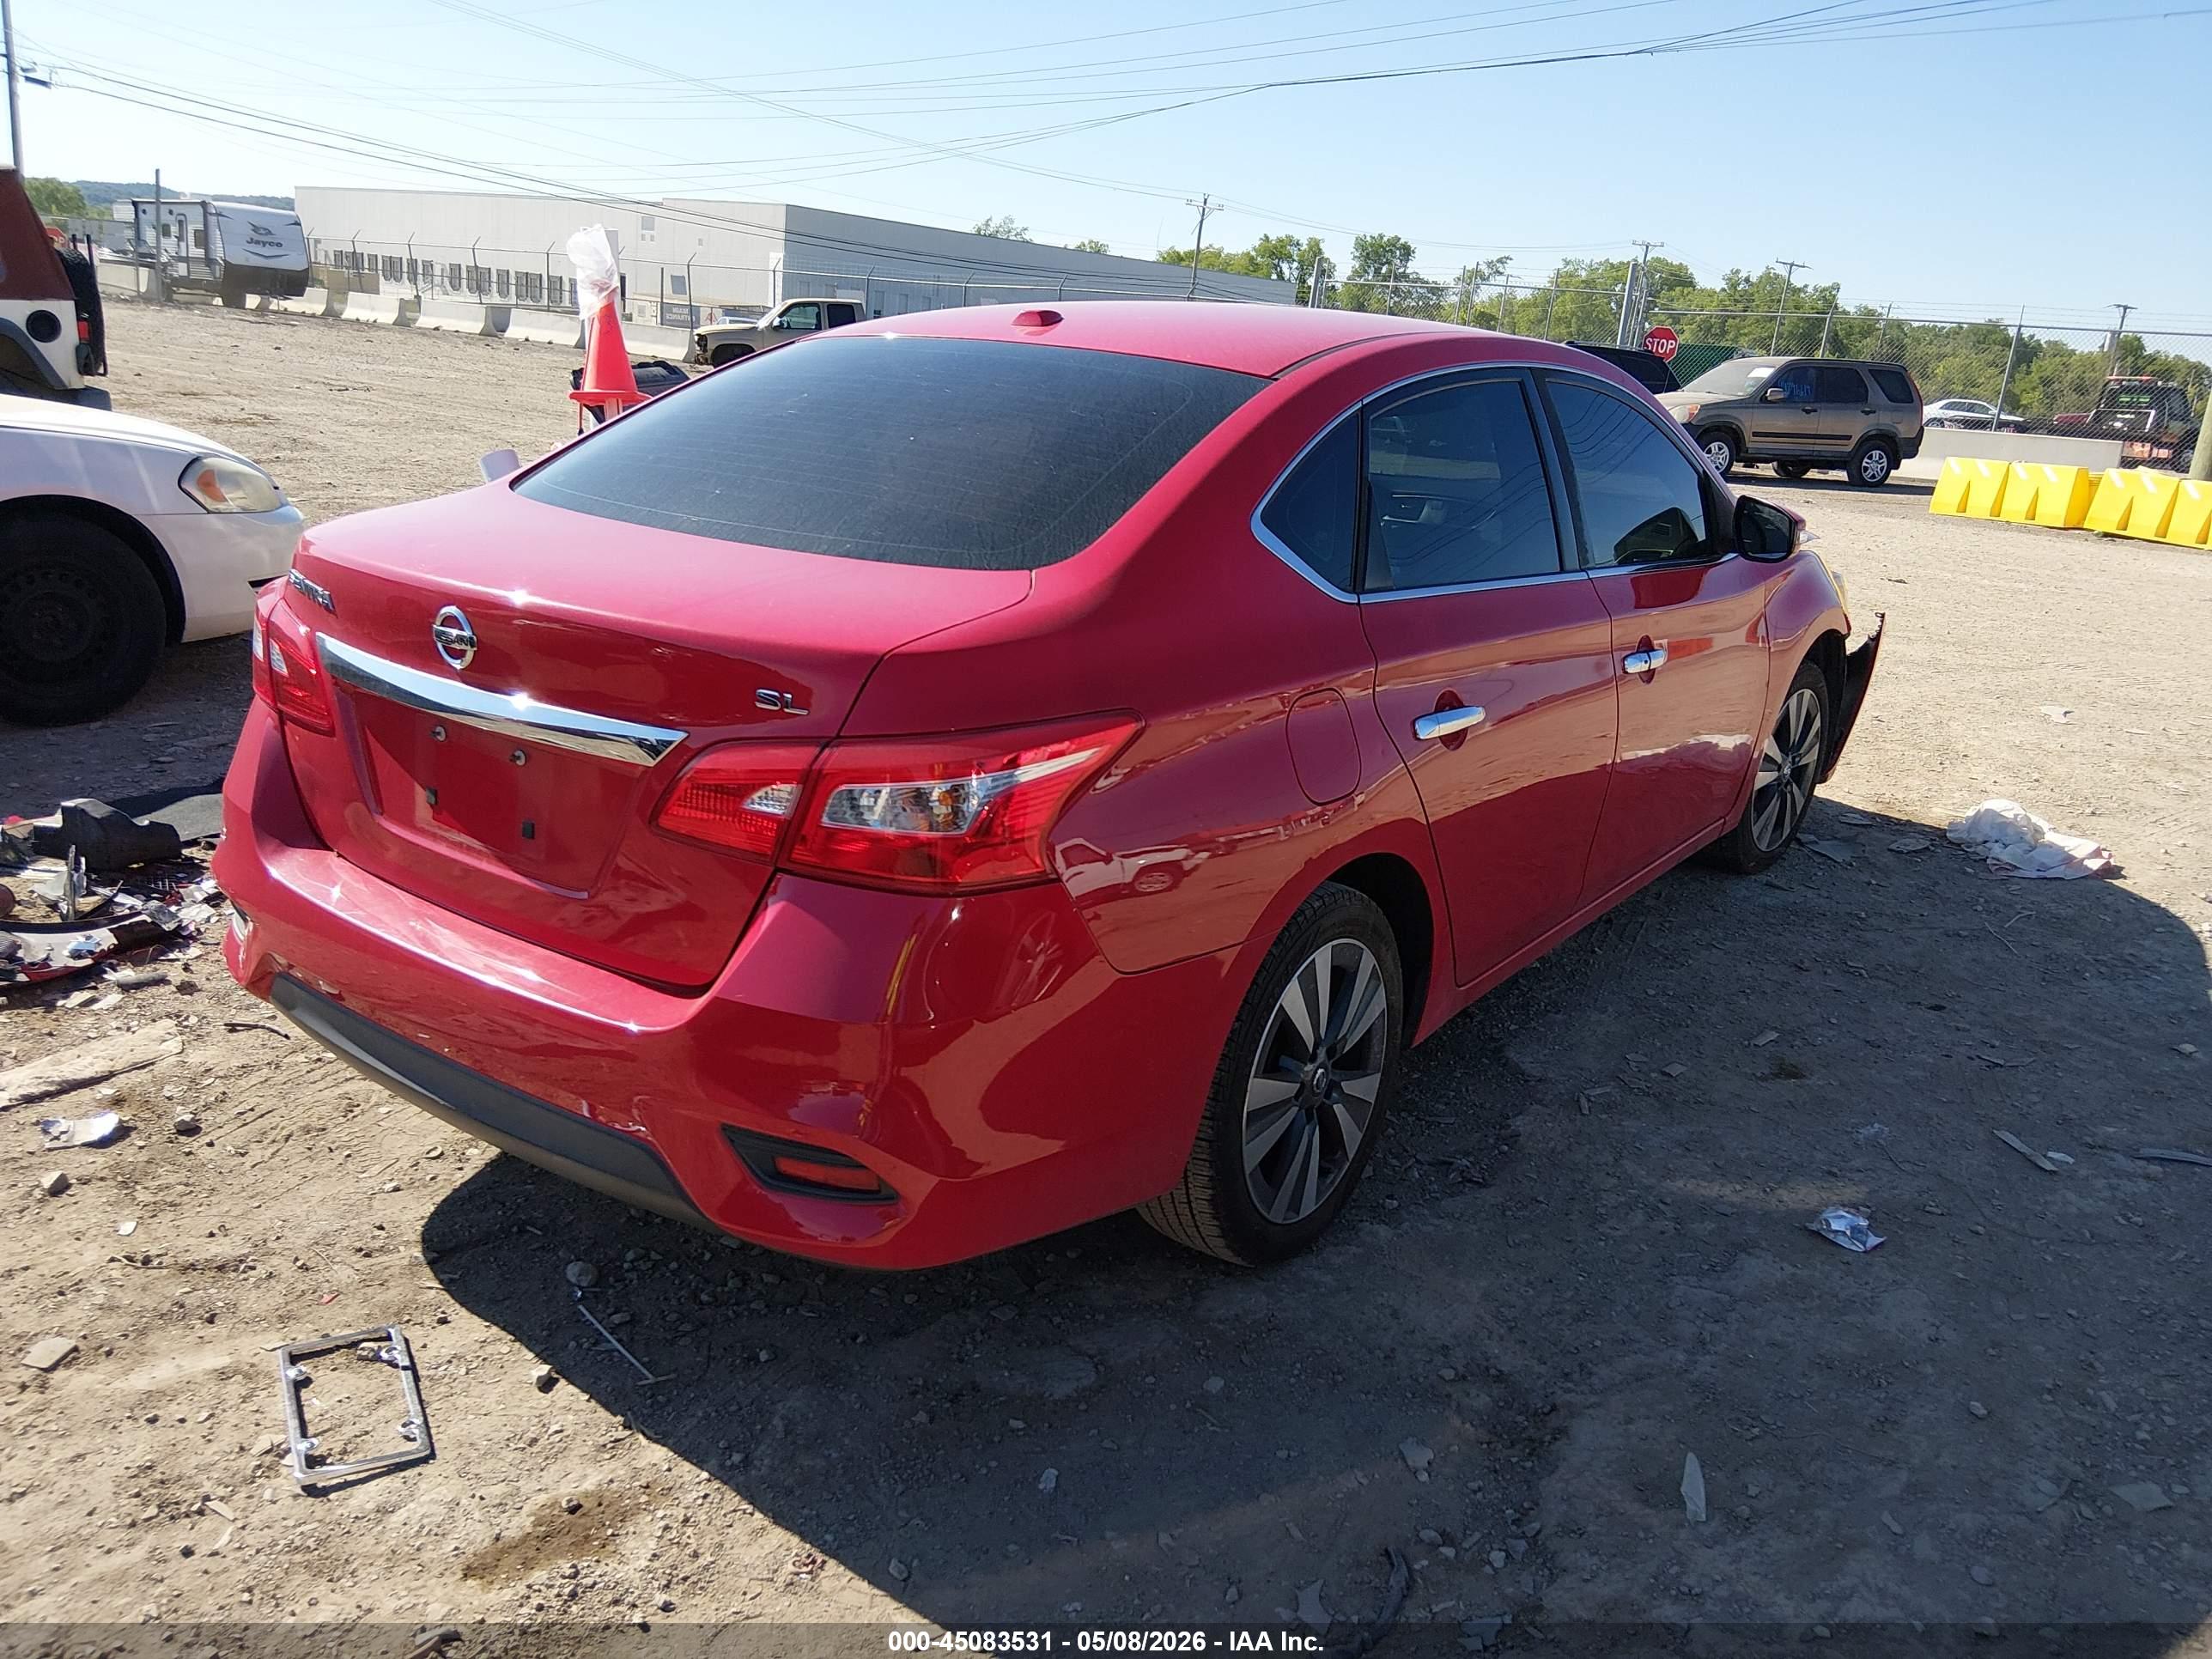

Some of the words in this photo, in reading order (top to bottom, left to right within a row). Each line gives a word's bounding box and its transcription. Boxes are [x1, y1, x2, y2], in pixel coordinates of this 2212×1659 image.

[246, 237, 283, 247] Jayco
[1644, 337, 1676, 354] STOP
[755, 689, 809, 714] SL
